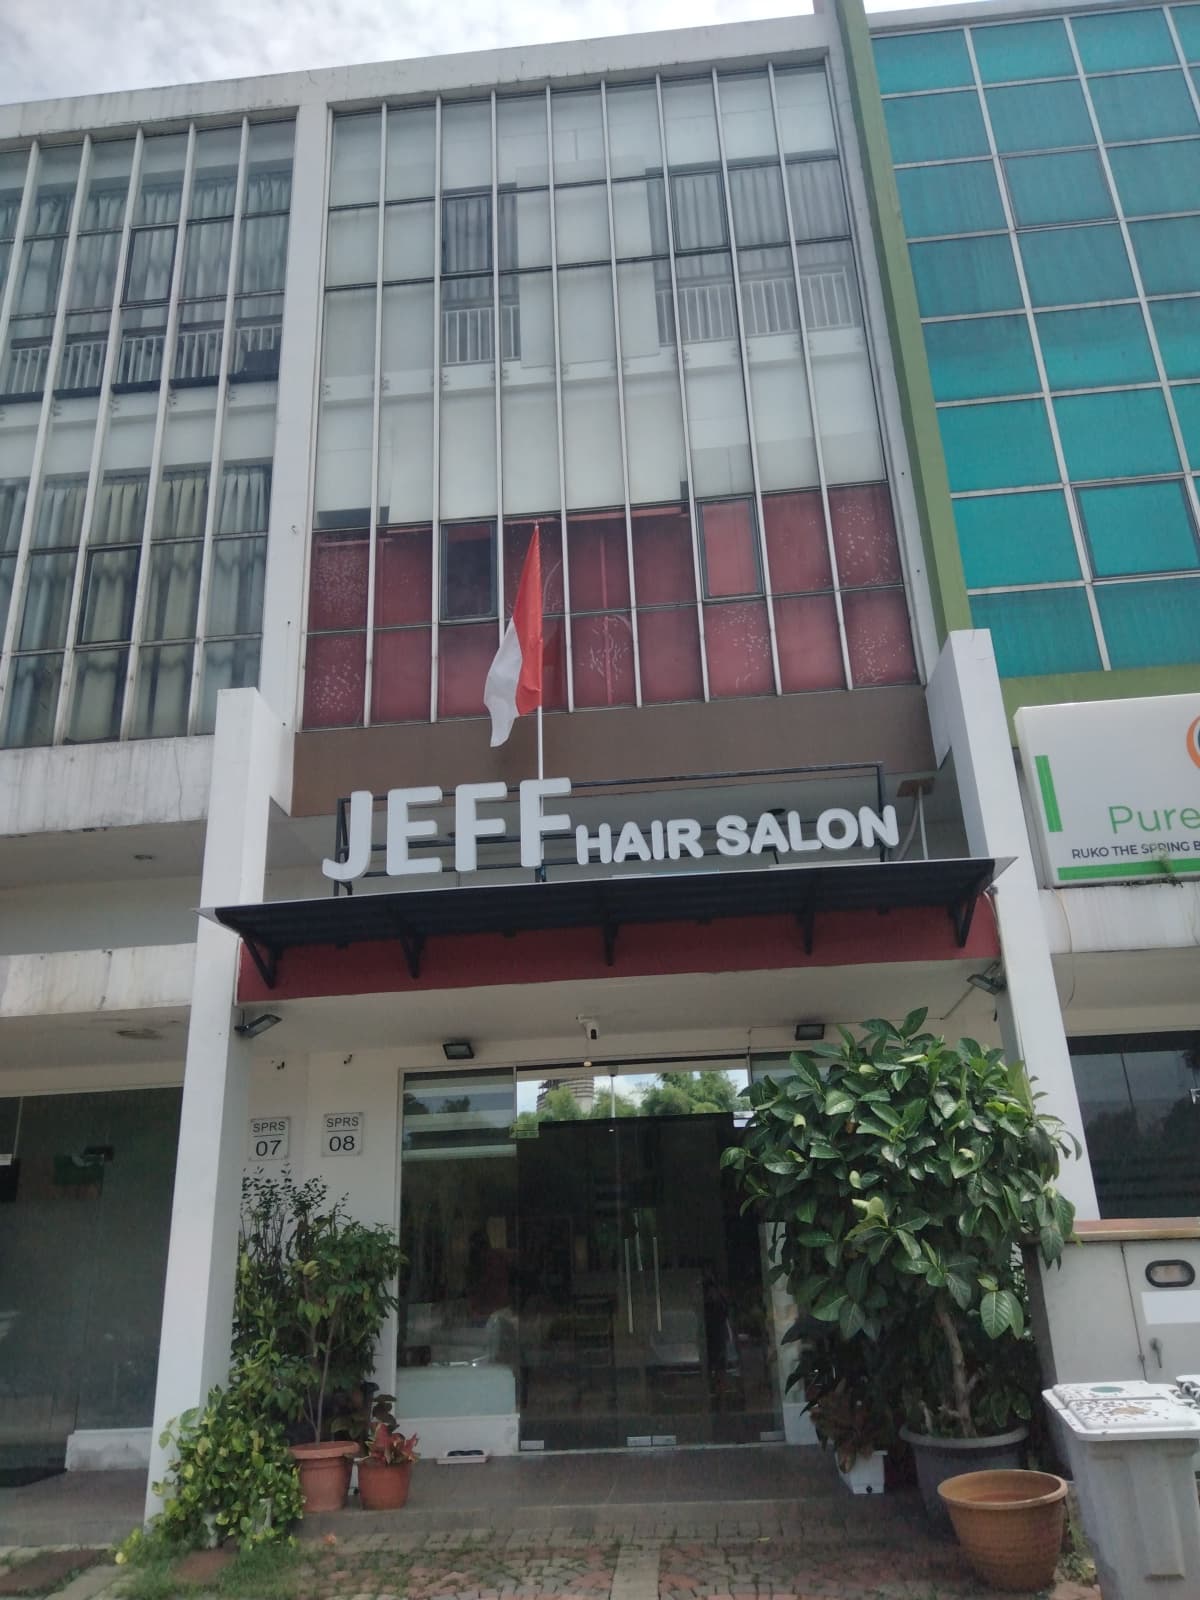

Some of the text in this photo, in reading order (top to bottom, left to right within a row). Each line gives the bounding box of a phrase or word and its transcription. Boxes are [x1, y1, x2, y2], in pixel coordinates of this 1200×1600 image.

[322, 777, 900, 882] JEFF HAIR SALON
[1071, 845, 1110, 860] RUKO
[1110, 843, 1139, 857] THE
[252, 1120, 286, 1134] SPRS
[326, 1115, 359, 1128] SPRS
[255, 1139, 282, 1157] 07
[329, 1135, 355, 1152] 08
